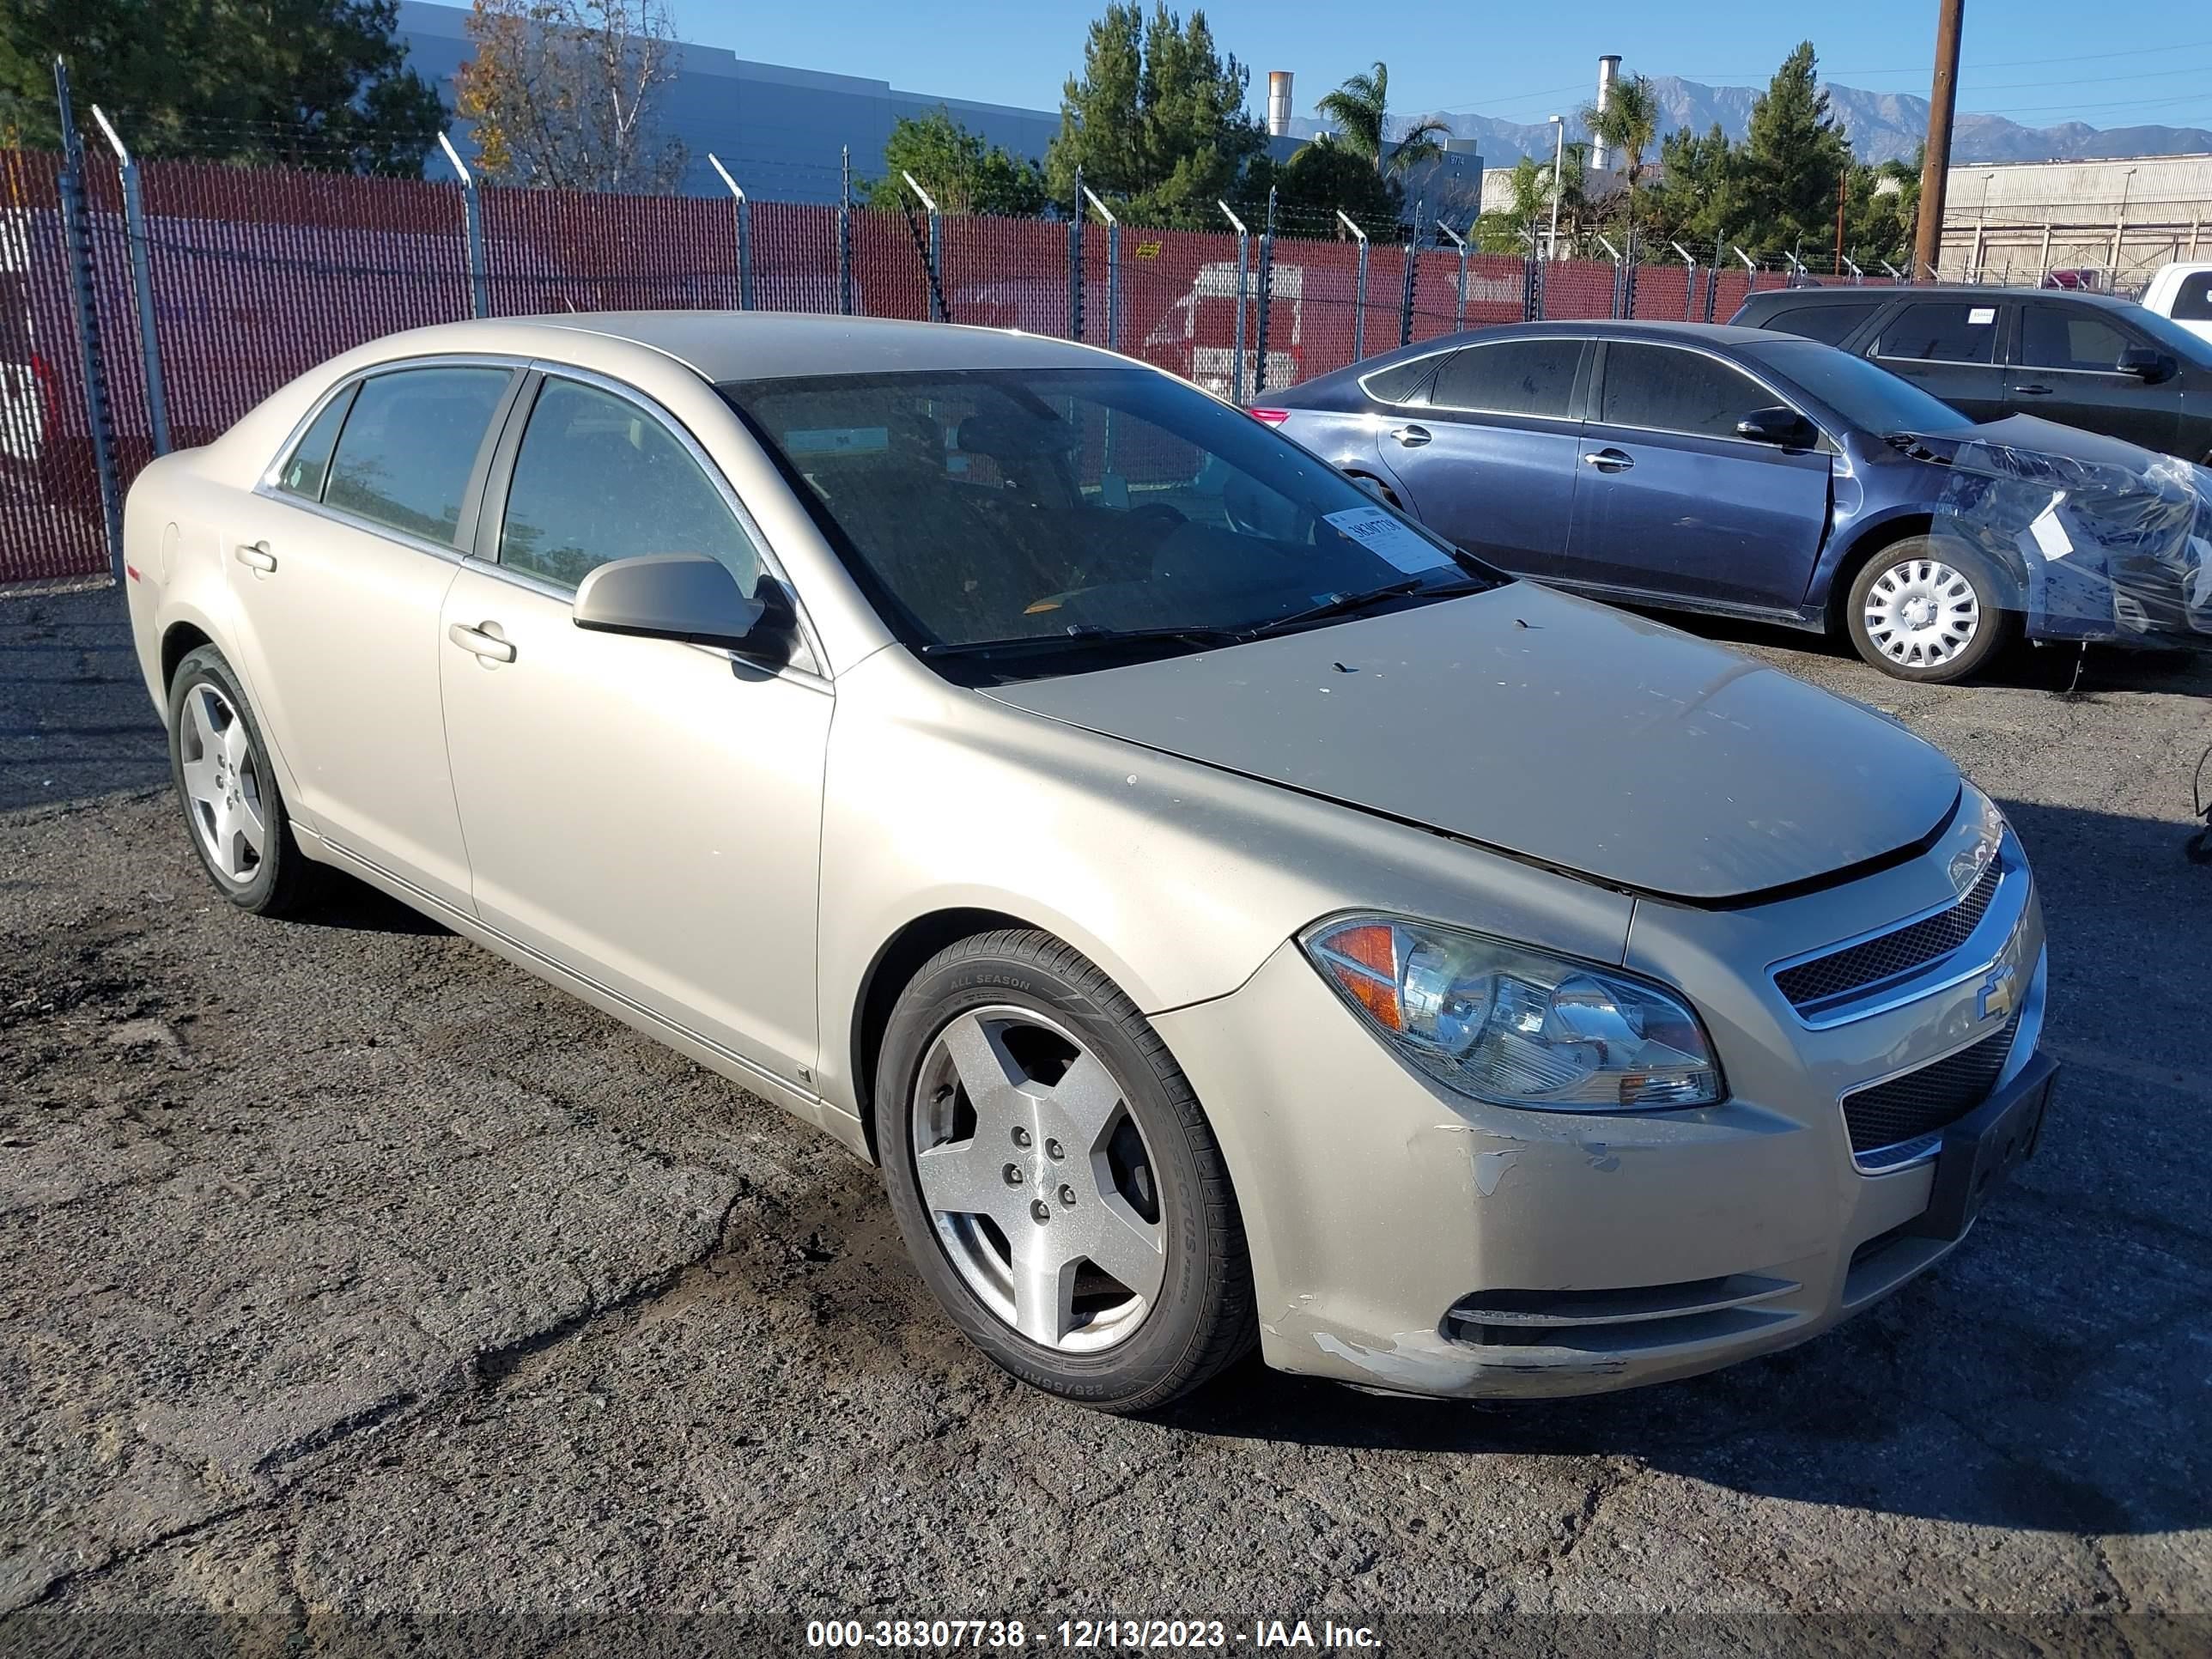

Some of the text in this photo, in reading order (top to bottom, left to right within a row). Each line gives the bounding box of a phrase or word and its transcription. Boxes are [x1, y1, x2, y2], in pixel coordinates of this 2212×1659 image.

[1347, 519, 1401, 538] 38307738
[950, 974, 1031, 990] ALL SEASON
